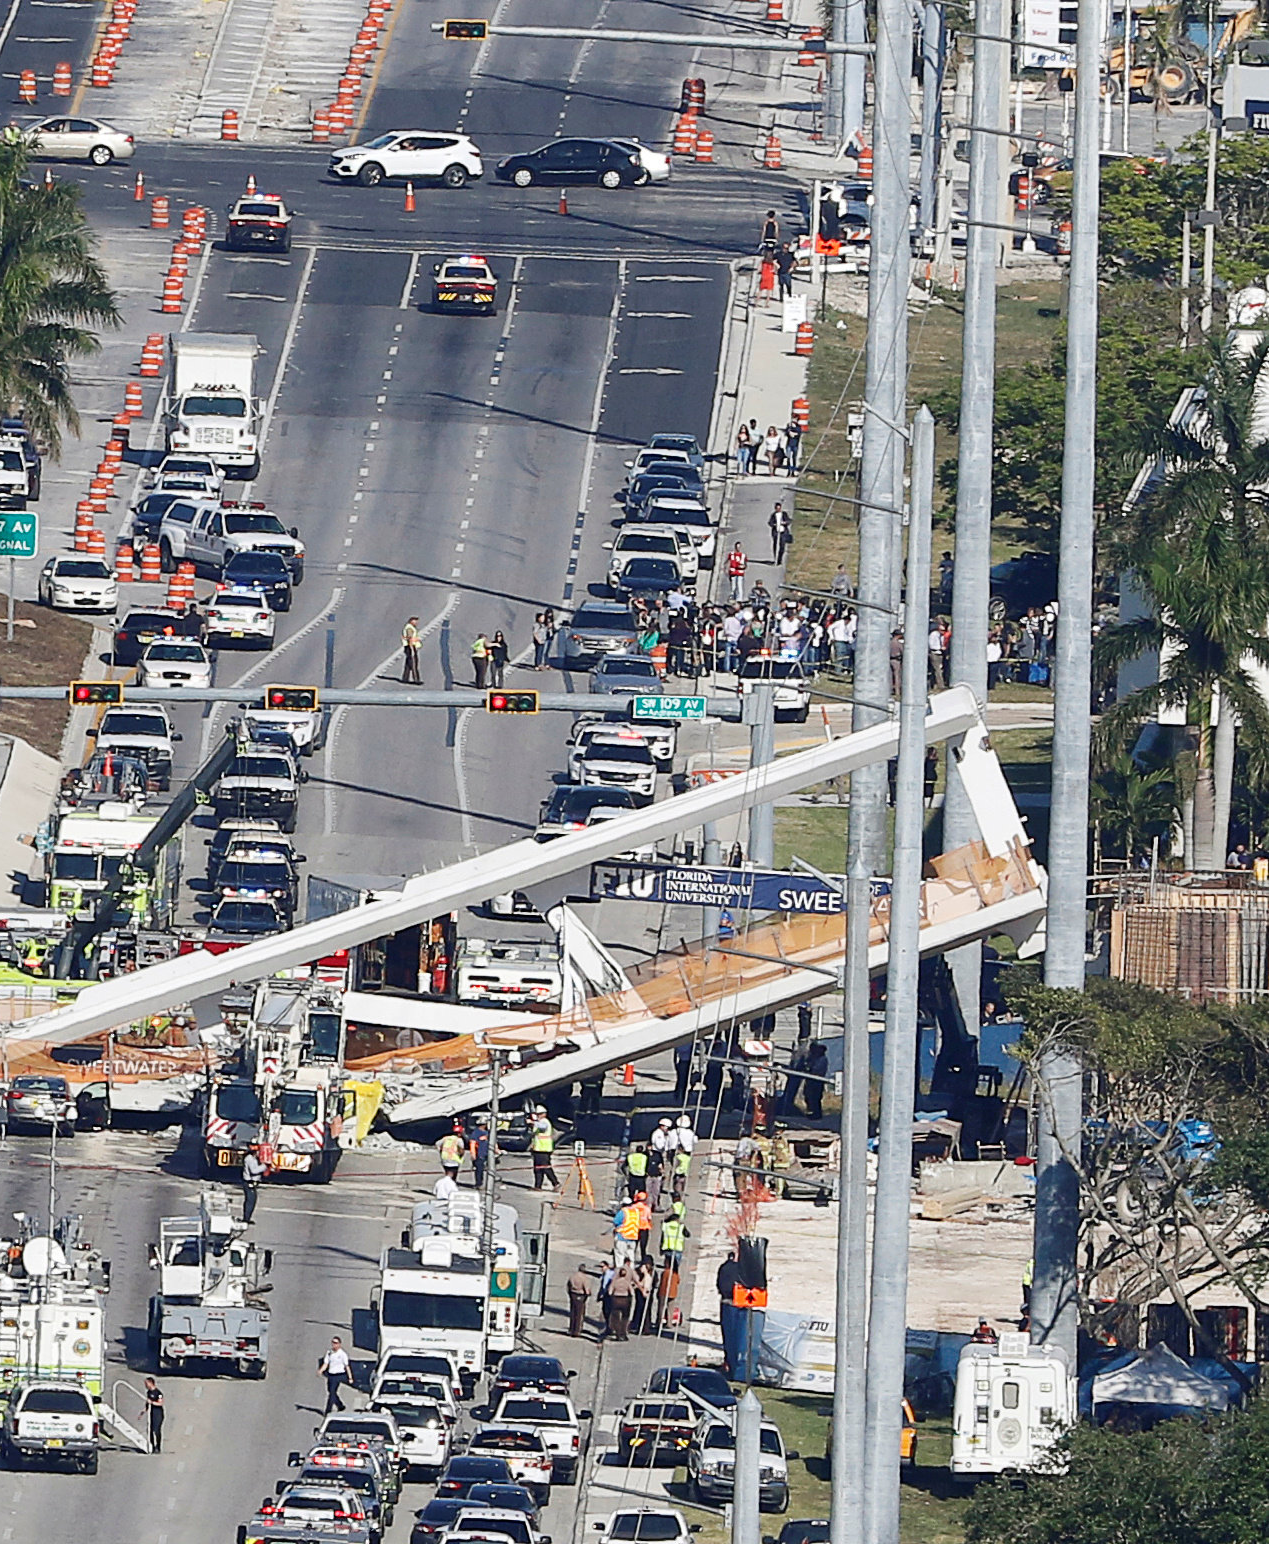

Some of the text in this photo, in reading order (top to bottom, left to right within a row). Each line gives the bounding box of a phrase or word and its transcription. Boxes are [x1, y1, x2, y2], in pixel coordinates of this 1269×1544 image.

[641, 698, 699, 710] SW 109 AV
[592, 865, 657, 899] FIU
[666, 869, 713, 883] FLORIDA
[666, 880, 752, 896] INTERNATIONAL
[665, 890, 732, 905] UNIVERSITY
[808, 1321, 829, 1331] FIU
